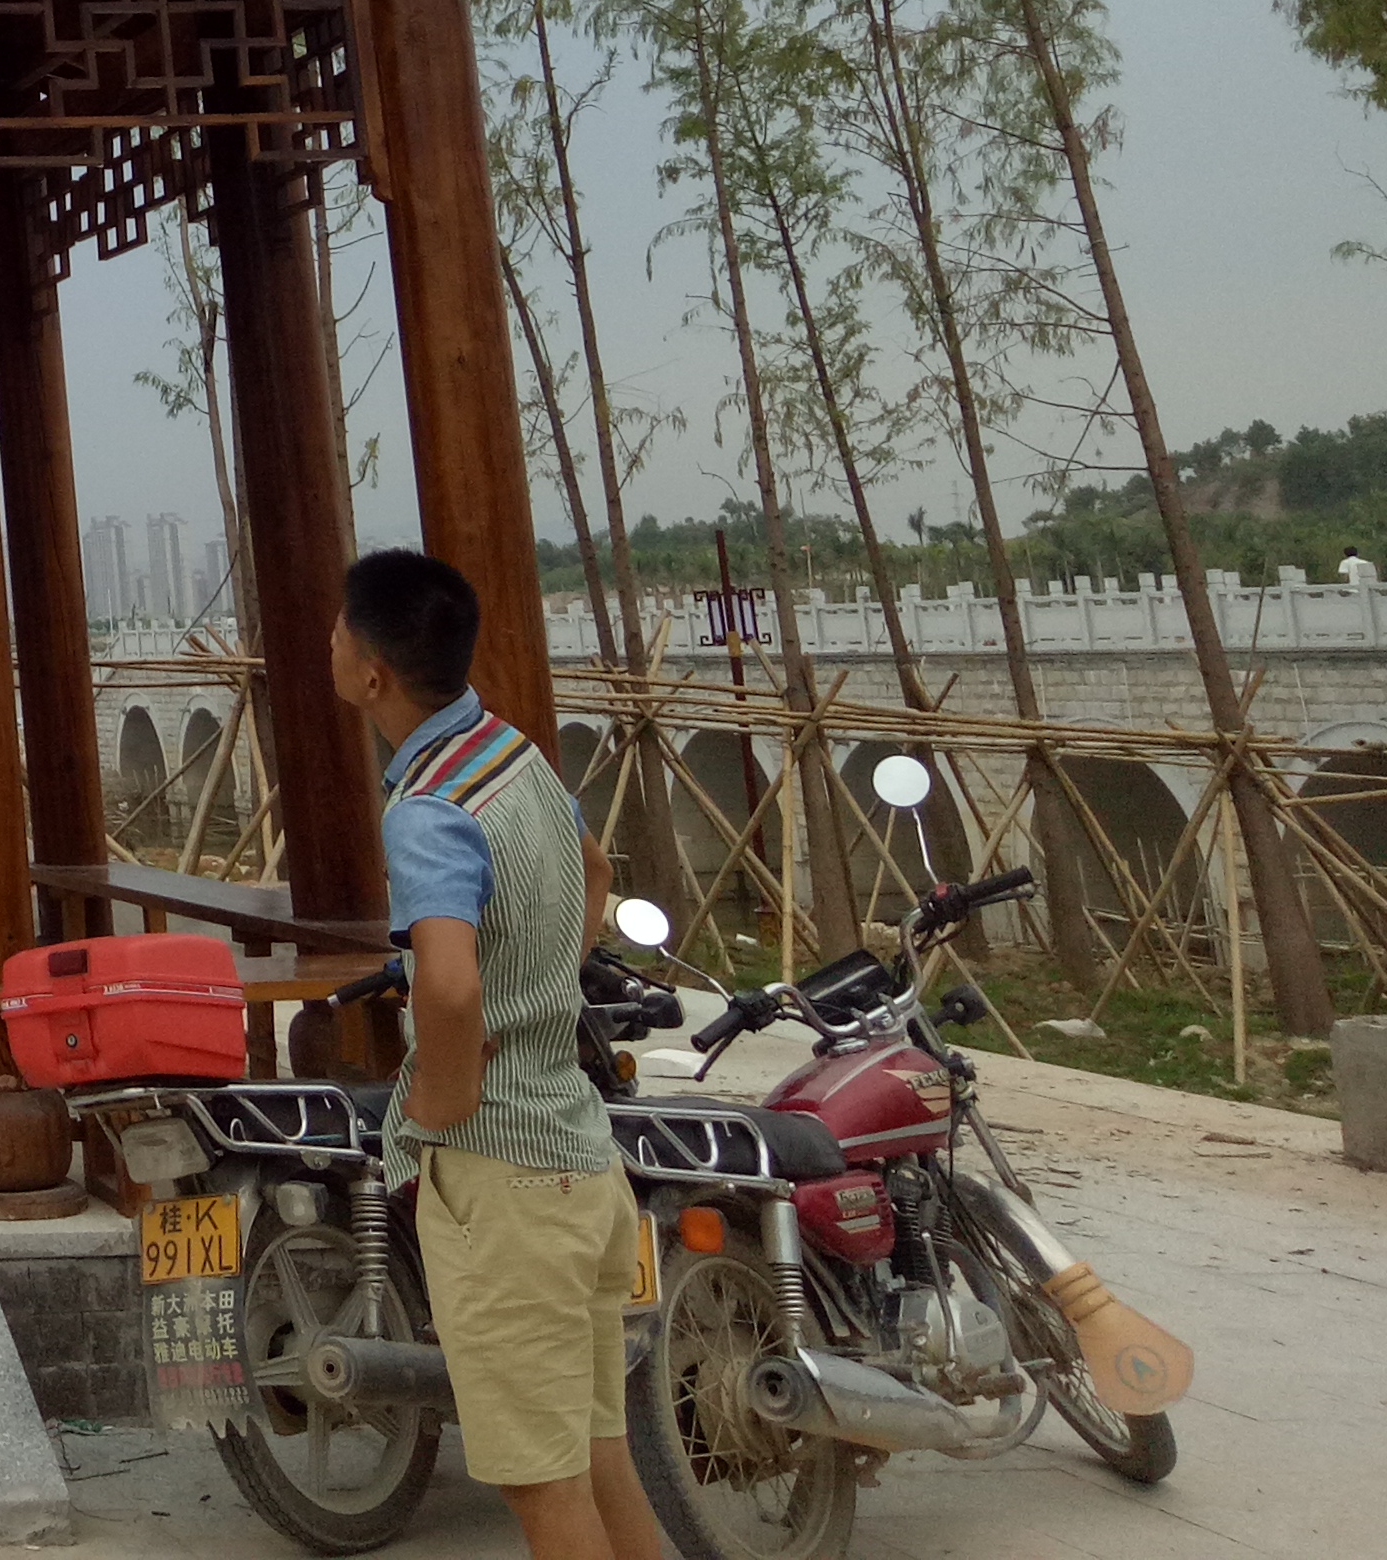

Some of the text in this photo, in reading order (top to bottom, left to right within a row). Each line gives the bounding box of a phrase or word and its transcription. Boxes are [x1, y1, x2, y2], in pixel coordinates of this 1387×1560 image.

[146, 1234, 234, 1278] 991XL
[153, 1336, 239, 1365] 雅迪电动车
